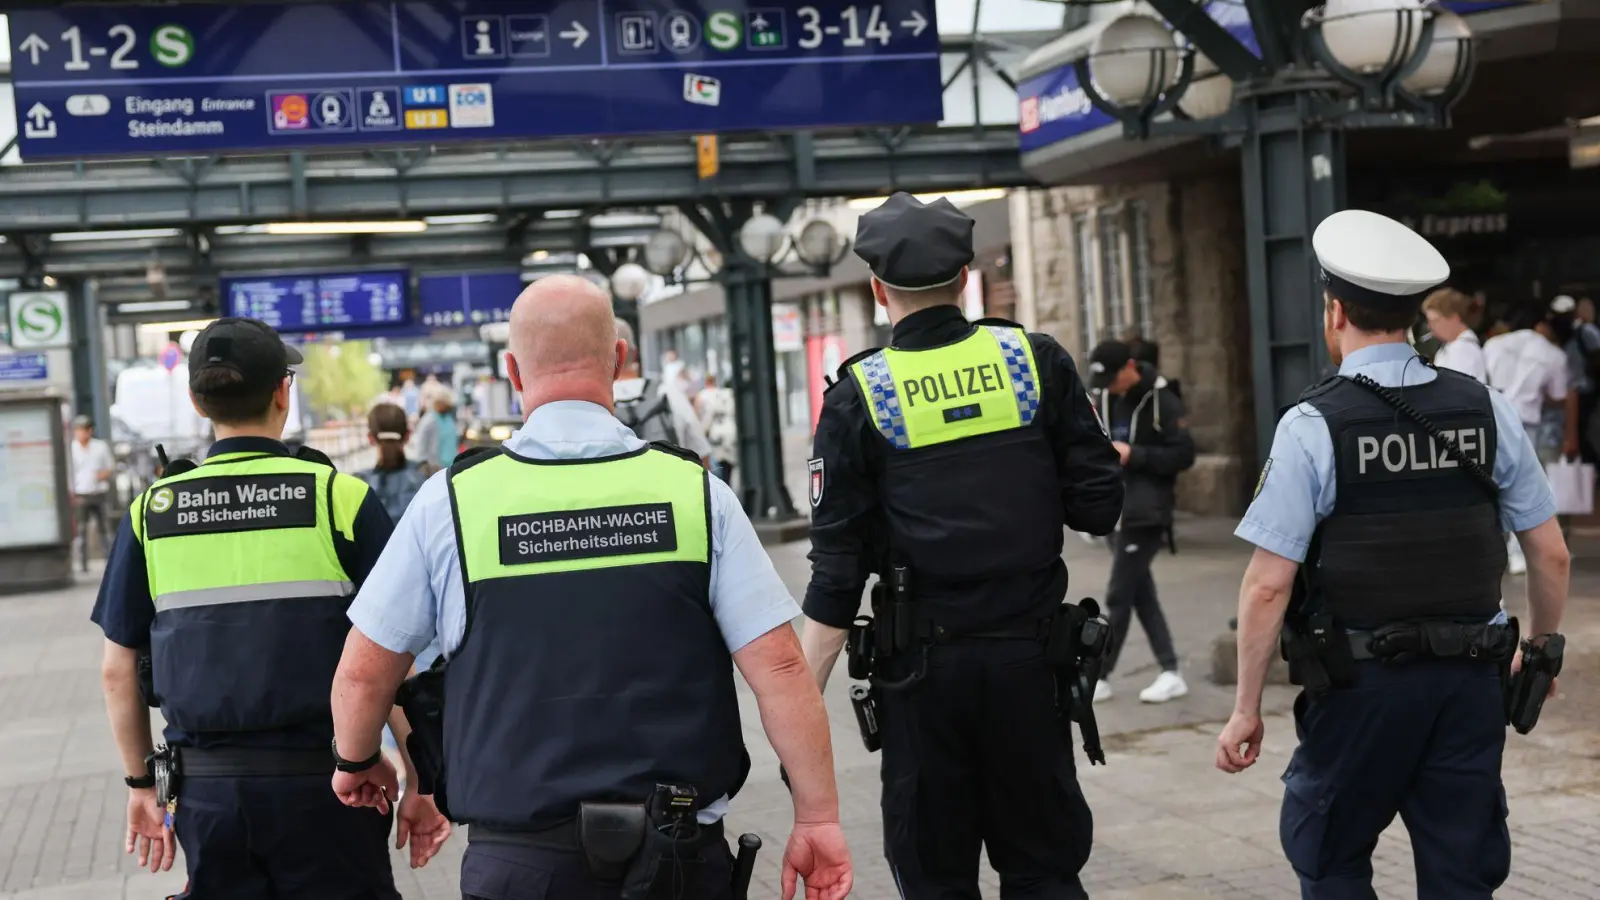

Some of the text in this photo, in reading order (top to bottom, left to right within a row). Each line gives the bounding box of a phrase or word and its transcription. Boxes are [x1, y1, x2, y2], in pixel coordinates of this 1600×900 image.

[708, 12, 739, 48] S
[797, 5, 891, 48] 3-14
[61, 24, 190, 71] 1-2 S
[125, 96, 194, 116] Eingang
[201, 97, 255, 112] Entrance
[412, 87, 437, 104] U1
[128, 118, 224, 138] Steindamm
[19, 300, 62, 341] S
[903, 363, 1004, 407] POLIZEI
[1357, 427, 1486, 475] POLIZEI
[177, 488, 230, 508] Bahn
[236, 483, 307, 504] Wache
[177, 504, 277, 525] DB Sicherheit
[506, 510, 668, 537] HOCHBAHN-WACHE
[518, 529, 659, 555] Sicherheitsdienst
